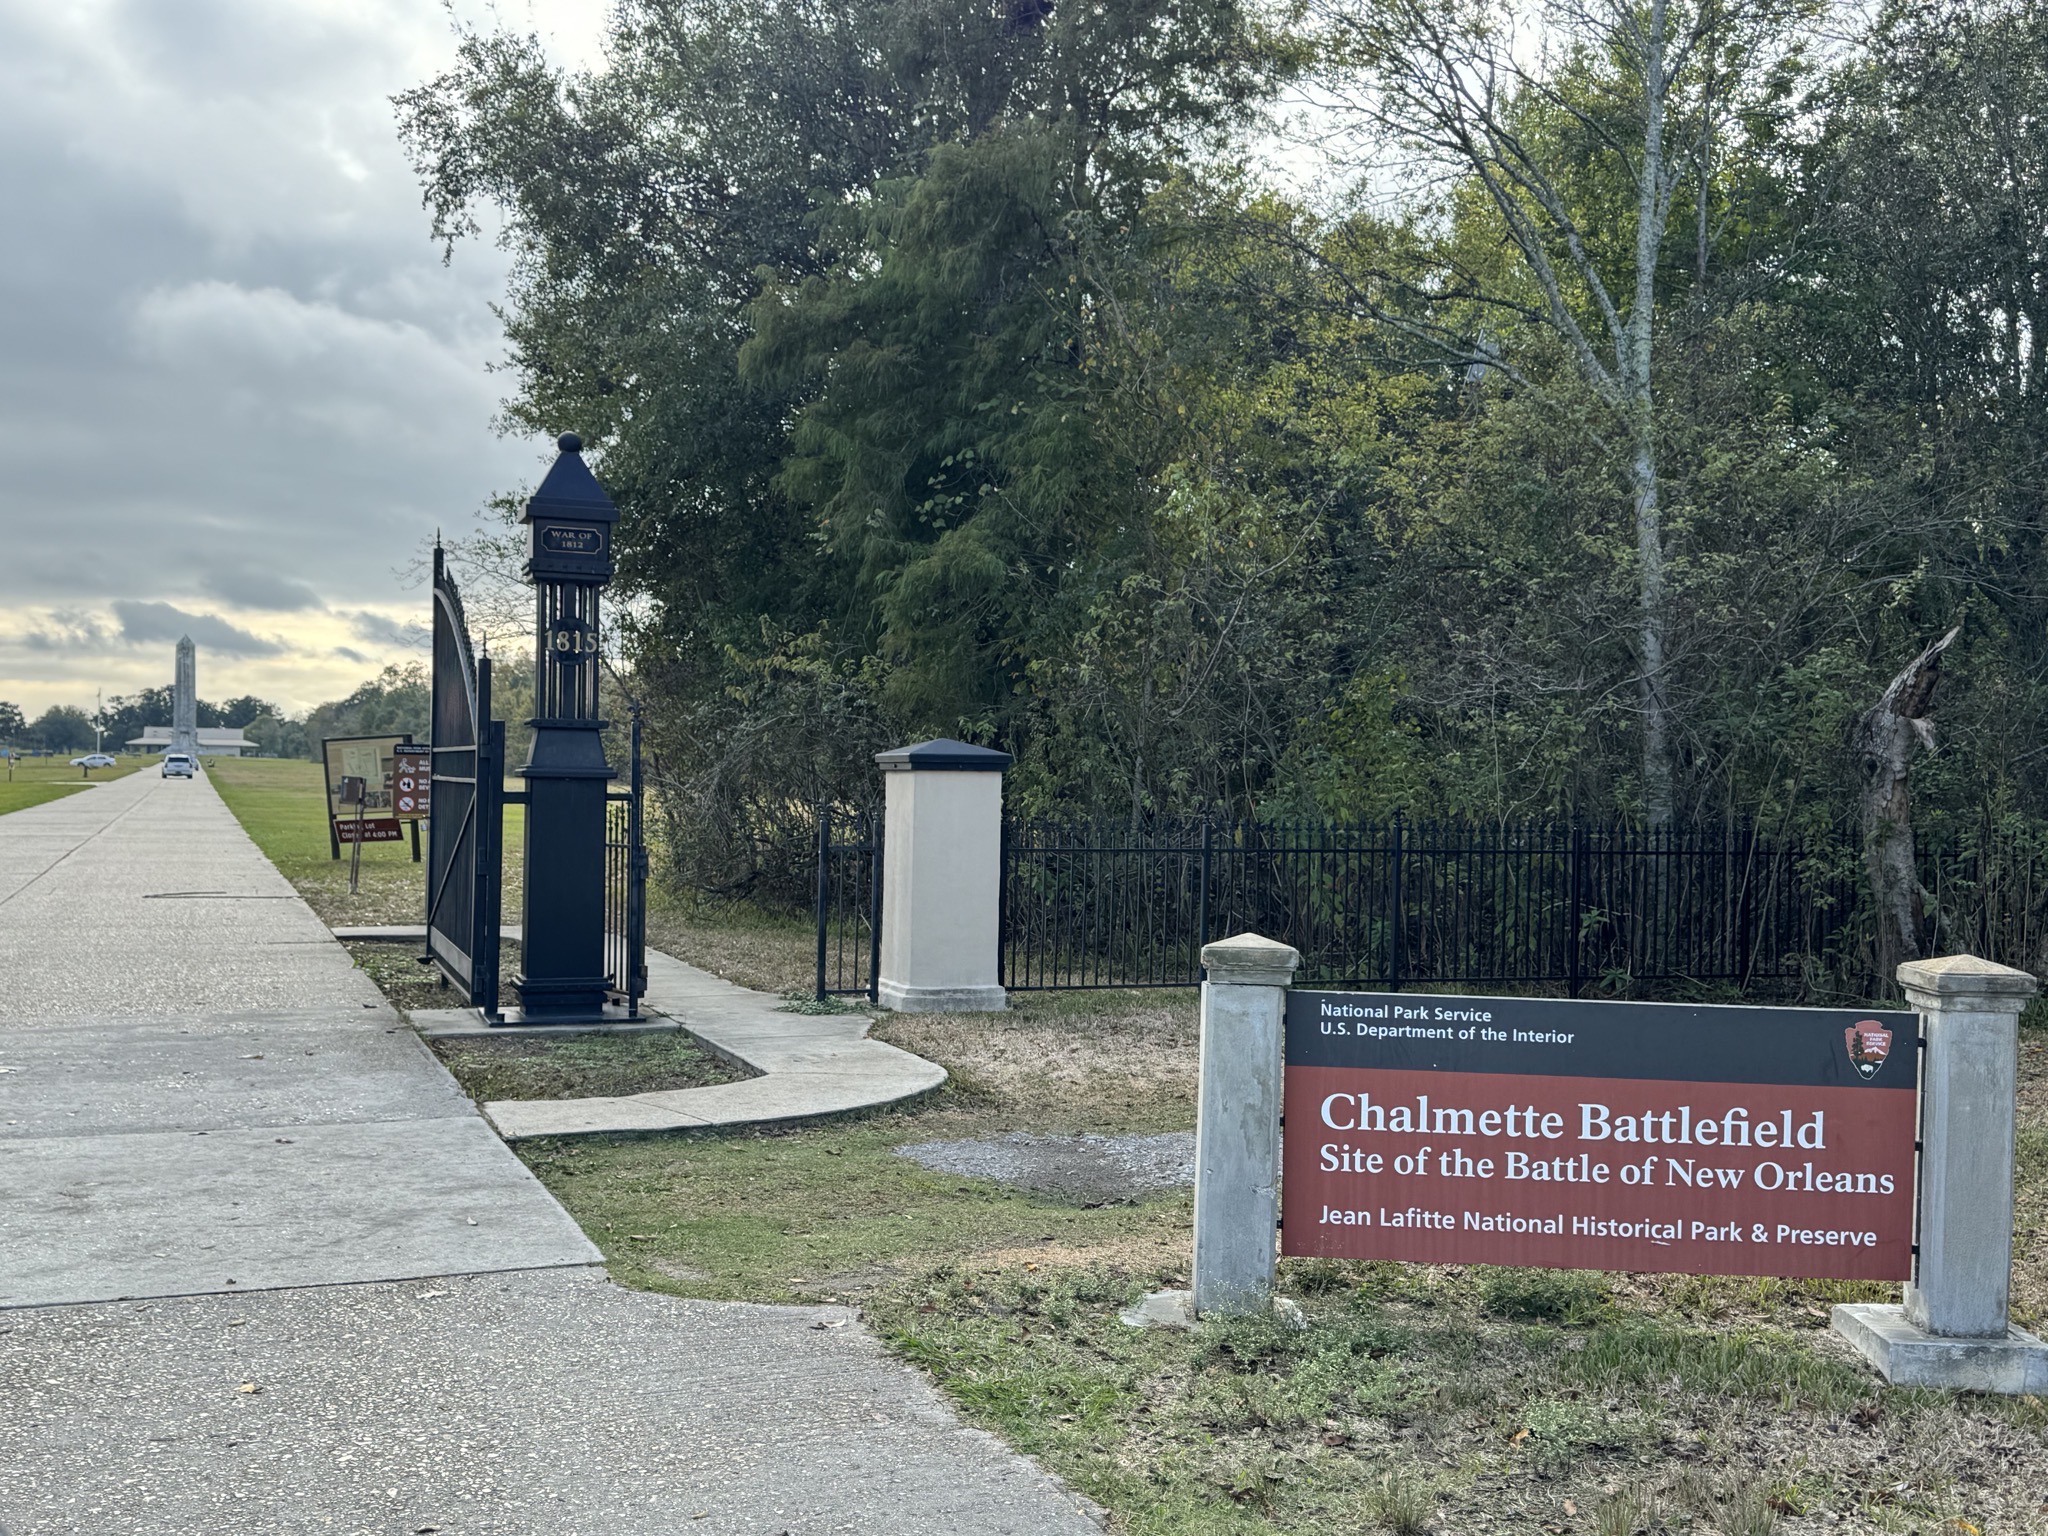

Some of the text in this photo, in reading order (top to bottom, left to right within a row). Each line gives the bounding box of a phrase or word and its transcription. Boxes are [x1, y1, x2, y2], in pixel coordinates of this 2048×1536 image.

[551, 530, 592, 540] WAR OF
[562, 540, 584, 548] 1812
[544, 630, 598, 653] 1815
[1320, 1003, 1493, 1022] National Park Service
[1320, 1021, 1575, 1044] U.S. Department of the Interior
[1320, 1092, 1826, 1150] Chalmette Battlefield
[1320, 1143, 1895, 1195] Site of the Battle of New Orleans
[1319, 1205, 1878, 1247] Jean Lafitte National Historical Park & Preserve
